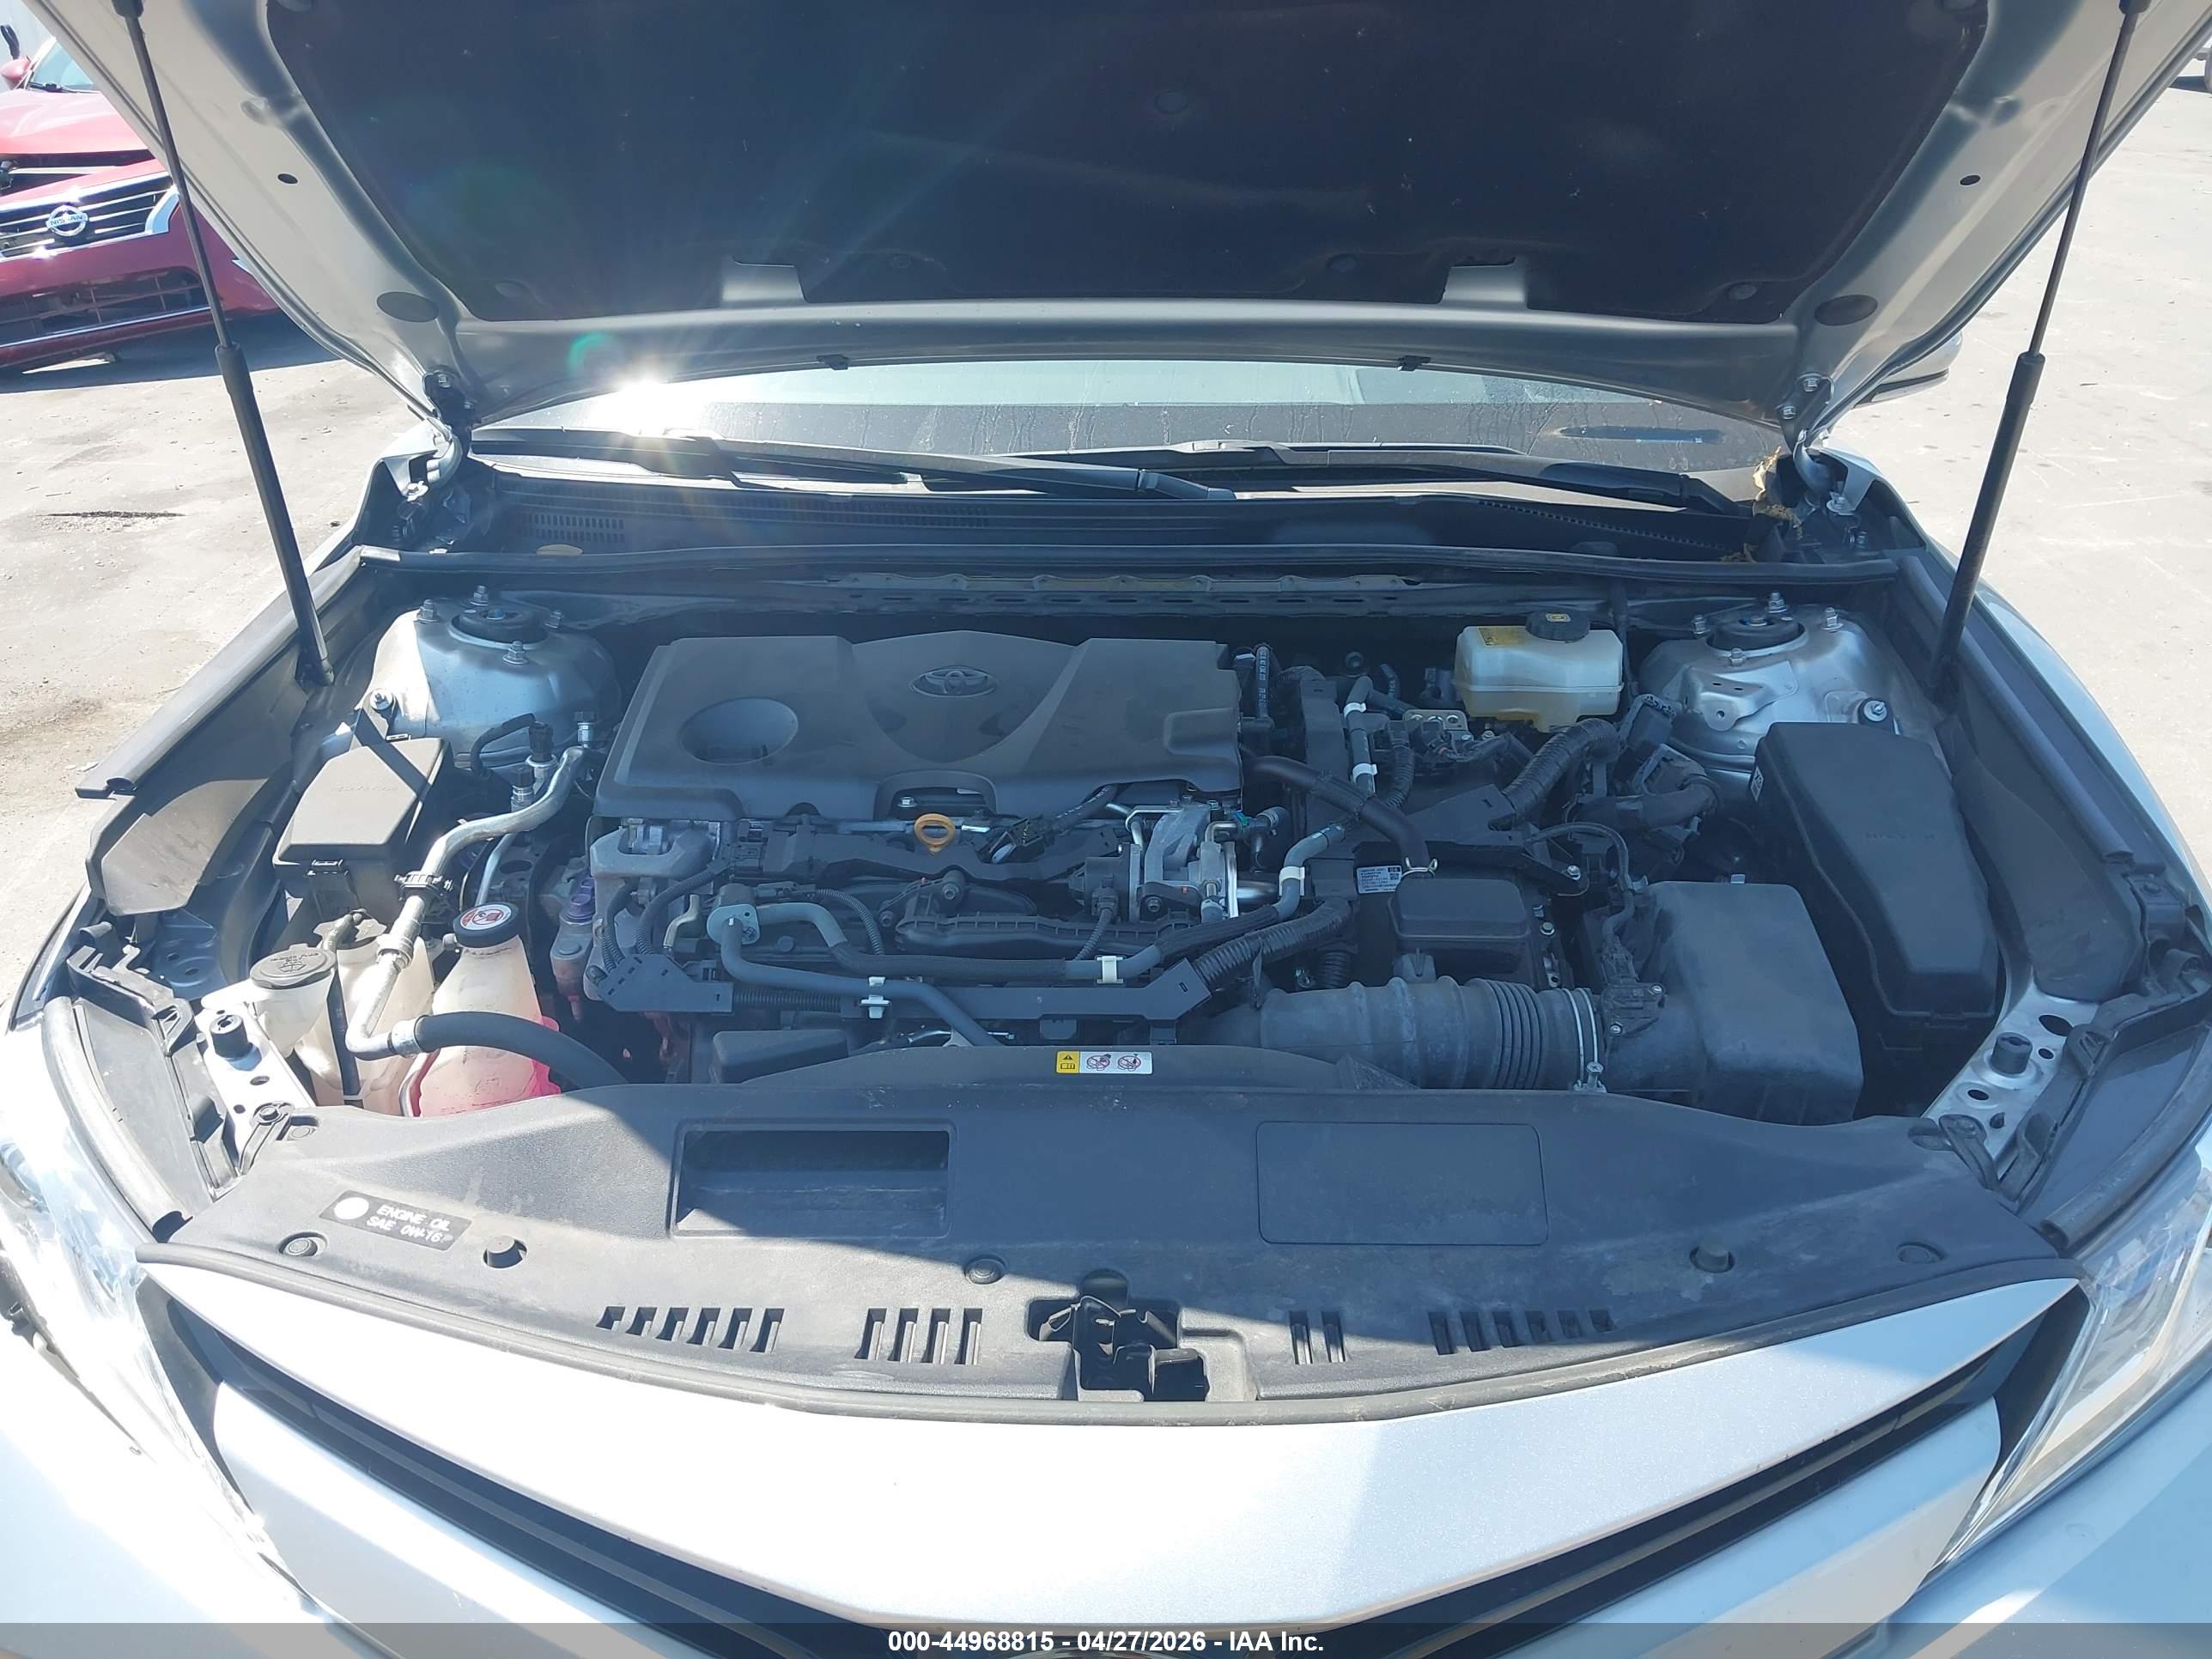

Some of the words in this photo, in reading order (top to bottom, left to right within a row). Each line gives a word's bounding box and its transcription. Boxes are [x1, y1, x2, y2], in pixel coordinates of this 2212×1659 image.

[50, 215, 83, 225] NISAN
[366, 1216, 397, 1231] SAE
[376, 1204, 427, 1224] ENGINE
[428, 1218, 451, 1232] OIL
